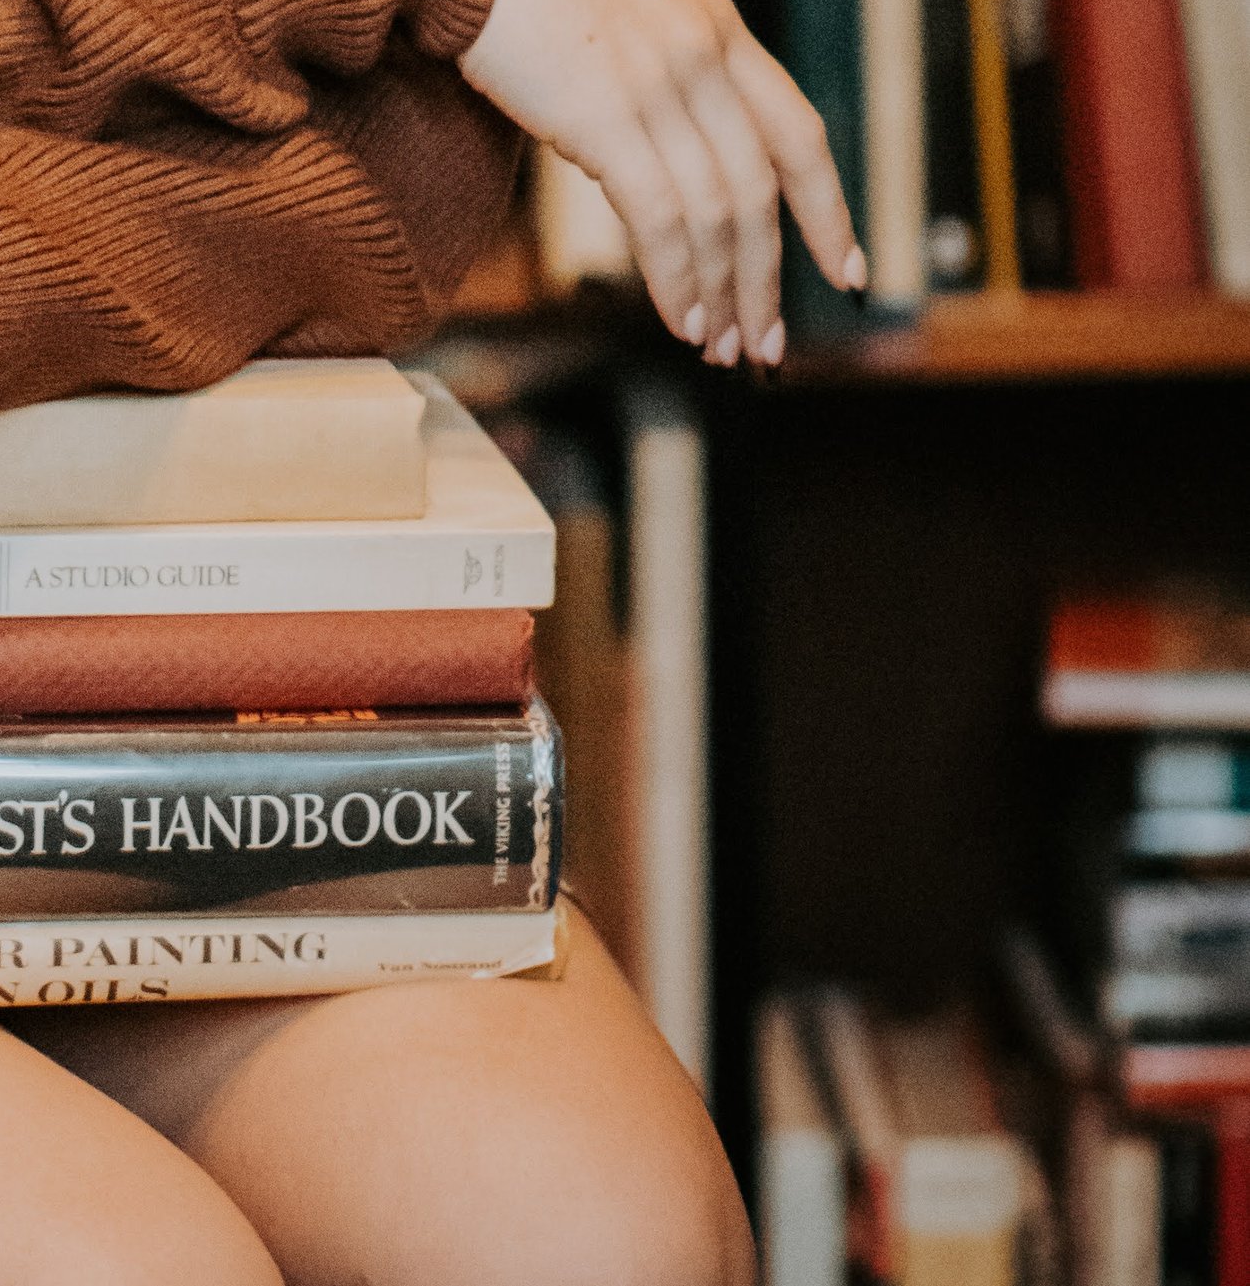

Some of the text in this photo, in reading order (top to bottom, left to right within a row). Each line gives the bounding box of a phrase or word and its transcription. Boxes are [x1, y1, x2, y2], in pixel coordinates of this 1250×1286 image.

[24, 564, 240, 589] A STUDIO GUIDE
[119, 790, 477, 852] HANDBOOK
[492, 741, 511, 886] THE VIKING PRESS
[48, 932, 327, 968] PAINTING
